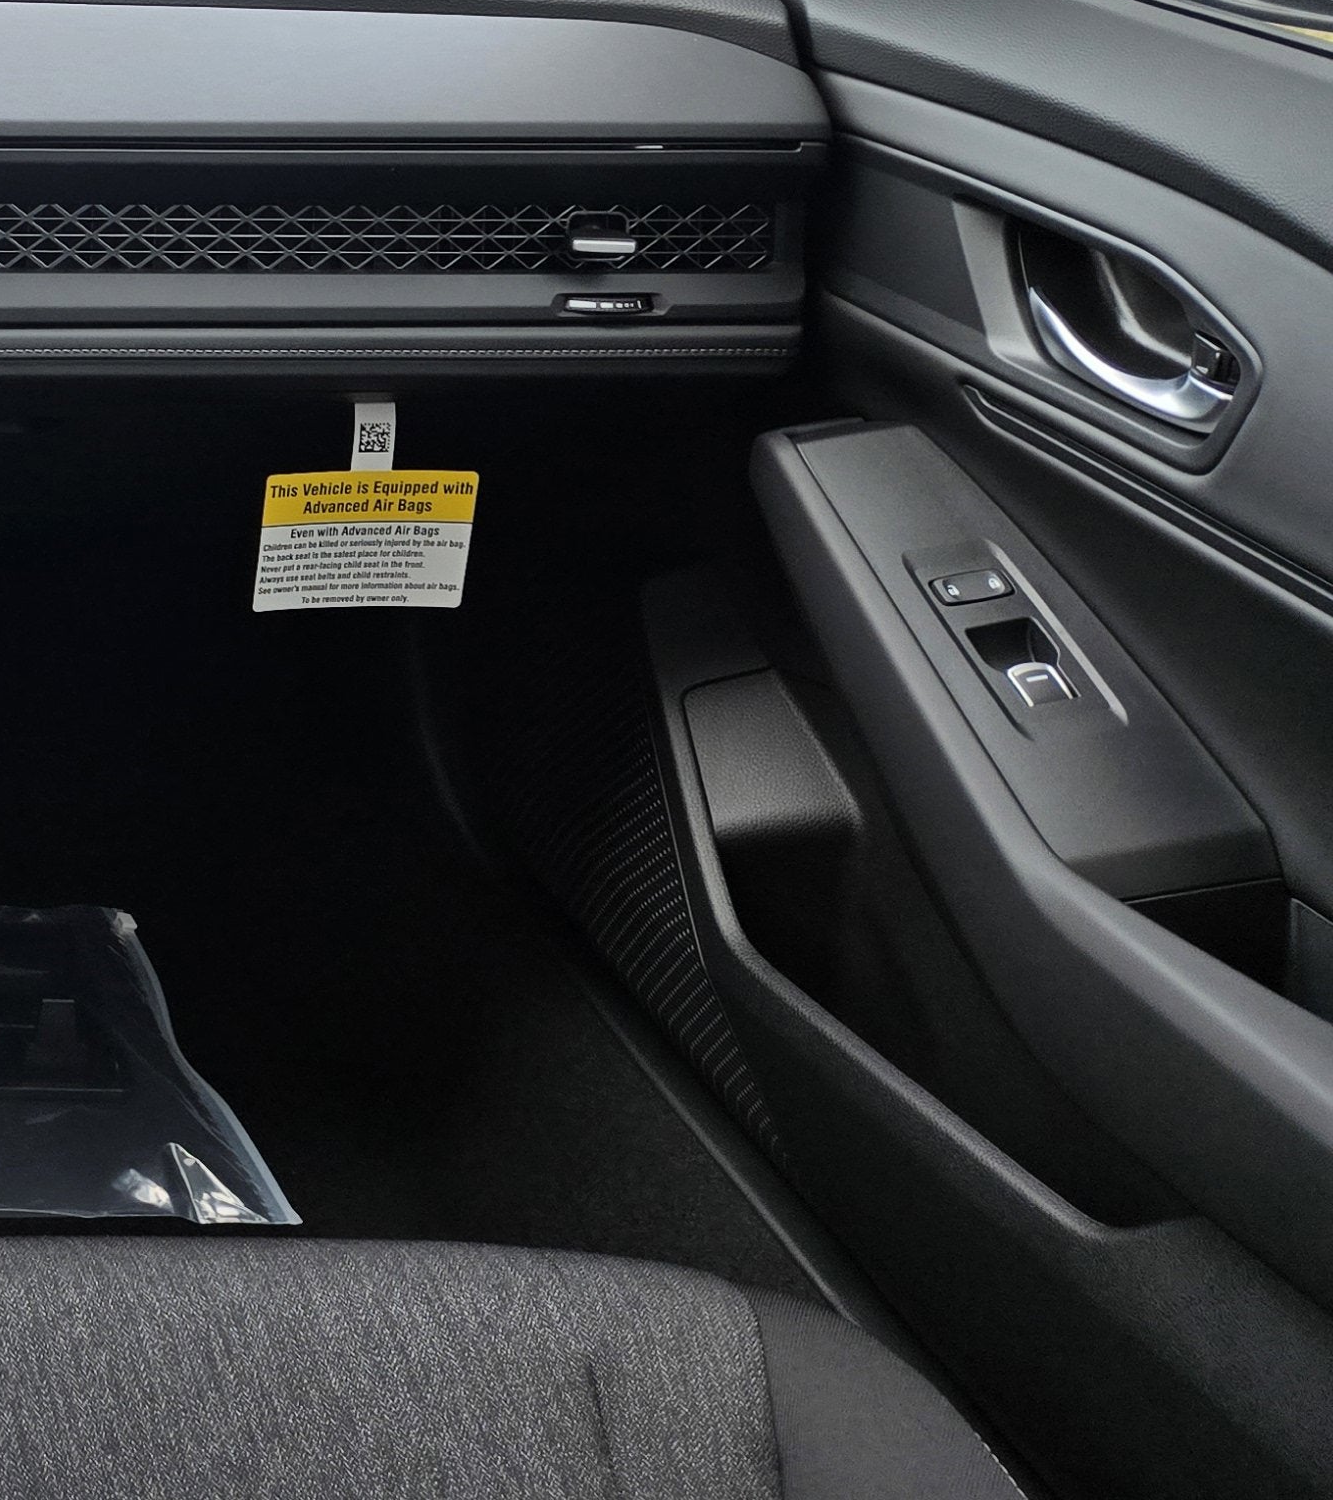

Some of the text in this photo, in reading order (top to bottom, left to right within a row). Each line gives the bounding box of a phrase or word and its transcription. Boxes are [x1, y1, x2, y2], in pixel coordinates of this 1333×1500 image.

[270, 481, 473, 498] This Vehicle is Equipped with
[303, 499, 432, 514] Advanced Air Bags
[290, 526, 440, 538] Even with Advanced Air Bags
[263, 543, 292, 551] Children
[319, 540, 339, 548] killed
[349, 539, 382, 548] seriously
[384, 539, 411, 548] injured
[413, 539, 421, 548] by
[423, 539, 435, 547] the
[277, 553, 293, 561] back
[295, 552, 310, 560] seat
[358, 550, 378, 559] place
[283, 564, 294, 572] put
[302, 562, 342, 570] rear-facing
[343, 561, 362, 569] child
